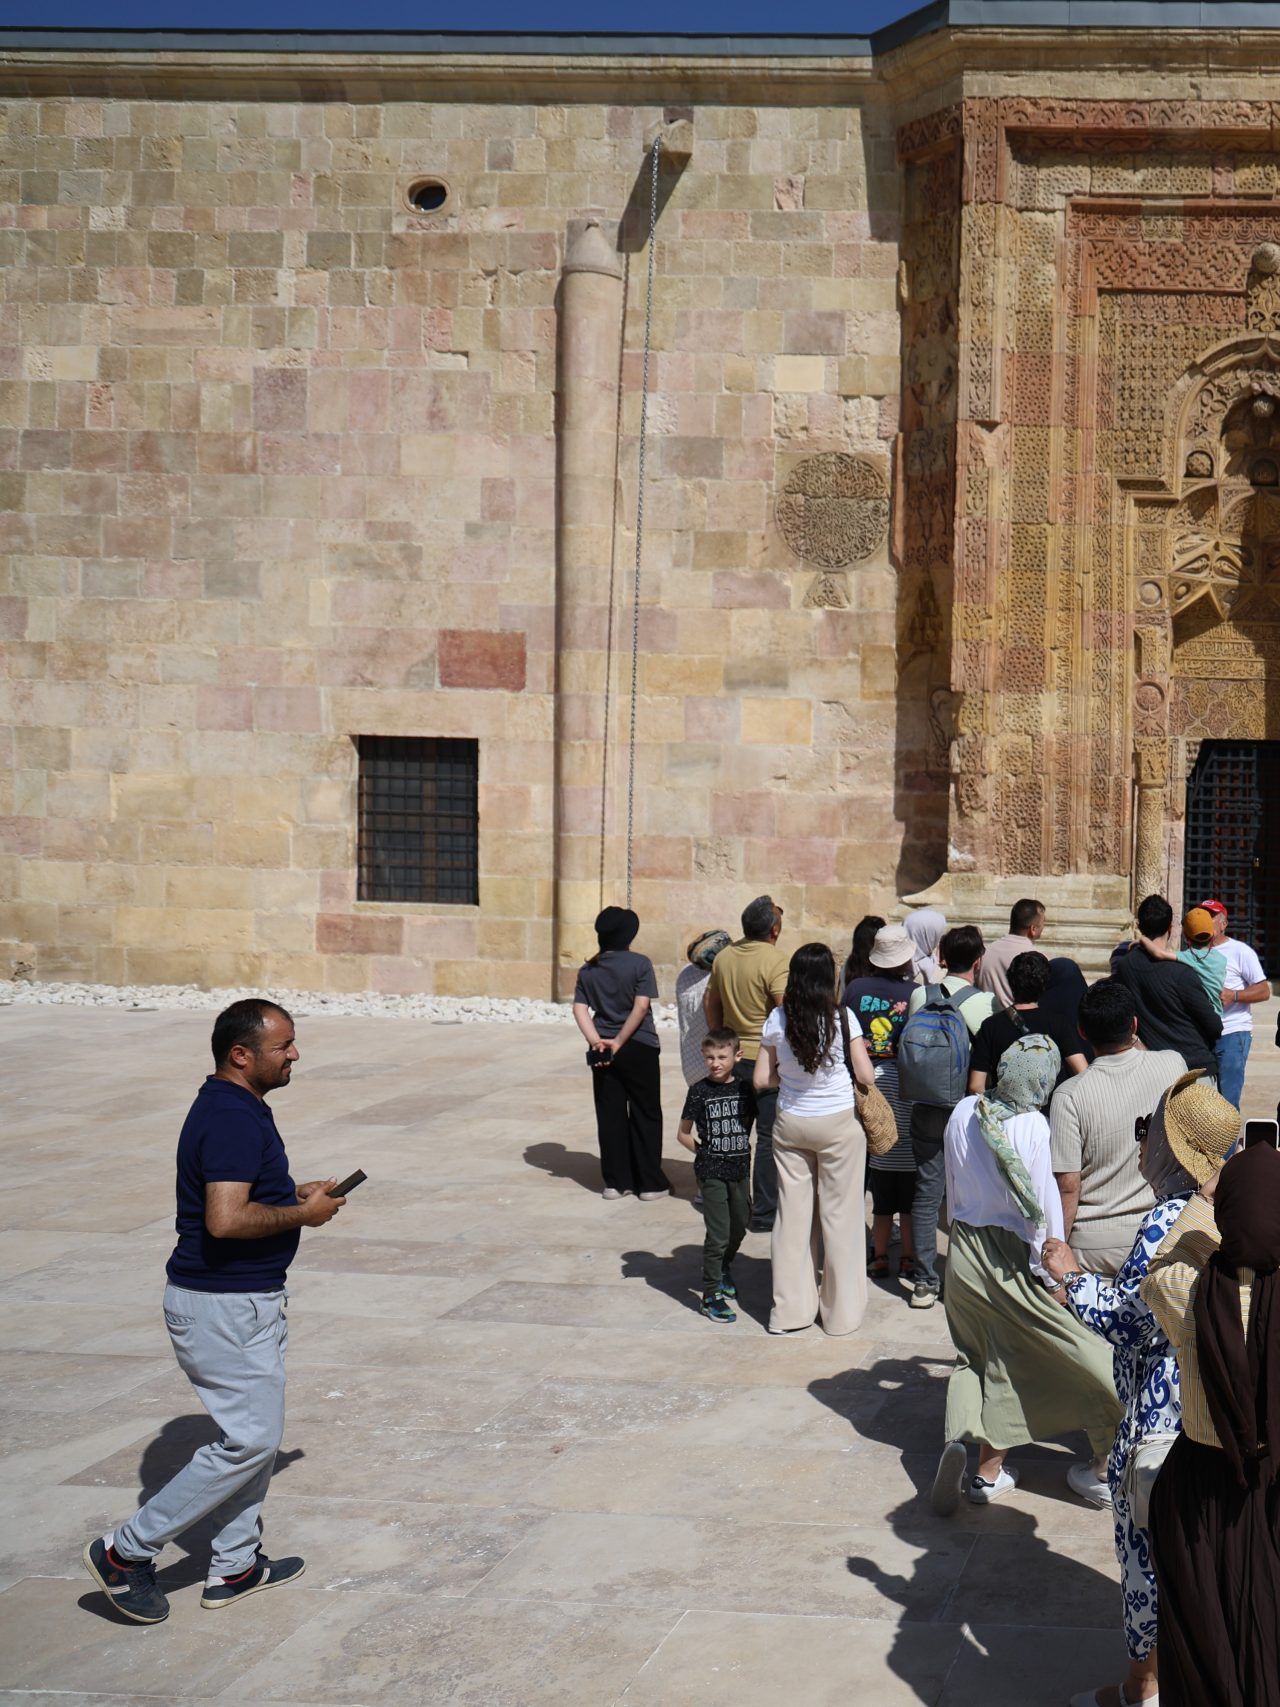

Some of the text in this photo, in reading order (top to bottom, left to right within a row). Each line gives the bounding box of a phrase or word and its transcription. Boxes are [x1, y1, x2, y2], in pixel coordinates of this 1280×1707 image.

[860, 995, 890, 1012] BAD
[708, 1100, 745, 1118] MAK
[711, 1118, 746, 1135] SOM
